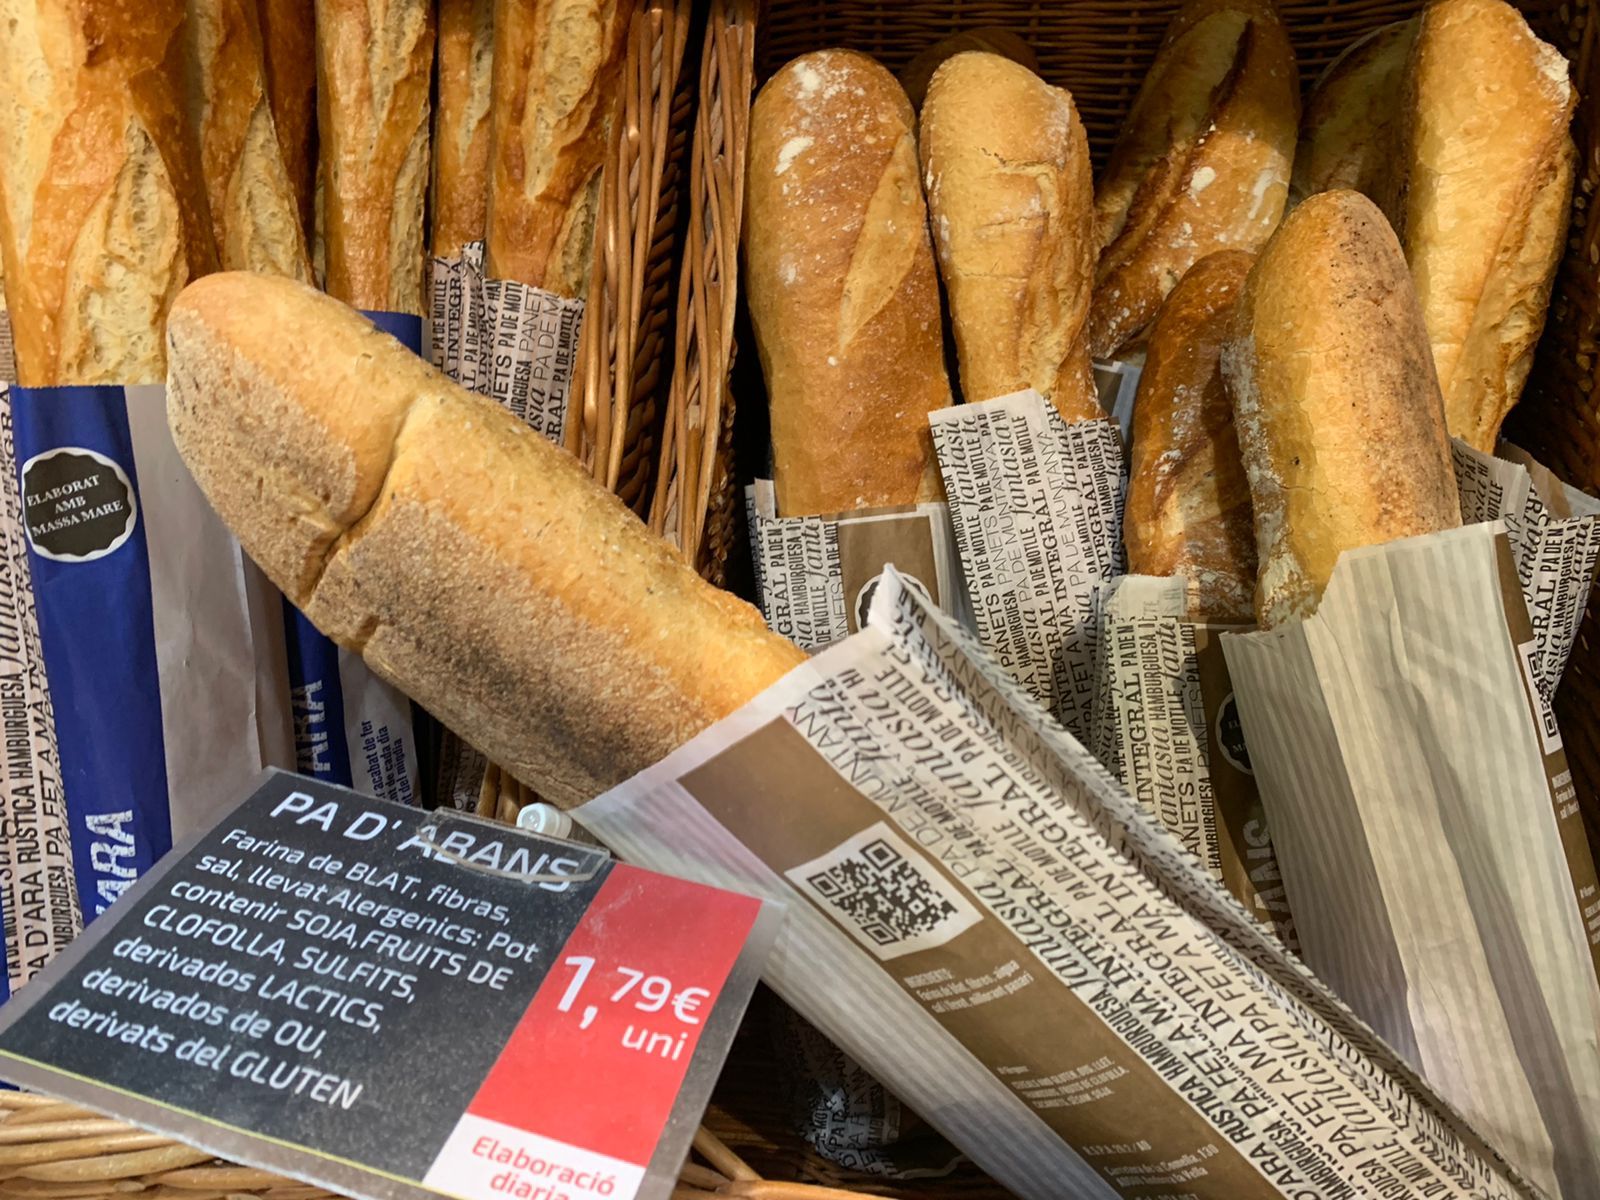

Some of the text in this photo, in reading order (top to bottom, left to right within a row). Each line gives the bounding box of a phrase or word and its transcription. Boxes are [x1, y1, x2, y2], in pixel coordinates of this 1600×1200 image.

[433, 279, 447, 350] PA DE MOTLLE
[498, 314, 518, 348] PA DE
[552, 306, 575, 382] PA DE MOTLLE
[464, 346, 477, 363] PA
[534, 323, 556, 381] PA DE
[1012, 415, 1035, 457] MOTLLE
[1023, 457, 1038, 471] DE
[1077, 456, 1088, 470] PA
[26, 474, 100, 507] ELABORAT
[54, 495, 87, 514] AMB
[1027, 470, 1040, 486] PA
[1087, 438, 1114, 514] HAMBURGUESA
[31, 499, 124, 538] MASSA MARE
[1032, 488, 1067, 602] INTEGRAL
[1072, 504, 1090, 544] MOTLLE
[769, 552, 785, 568] PA
[786, 535, 809, 616] HAMBURGUESA
[967, 438, 1032, 668] HAMBURGUESA PANETS PA DE MOTLLE
[985, 442, 1053, 699] fantasia PA DE MUNTANYA
[995, 425, 1076, 713] INTEGRAL PA DE MOTLLE fantasia
[1069, 561, 1086, 586] PA
[1540, 539, 1562, 573] PA DE
[1552, 536, 1575, 629] HAMBURGUESA
[810, 586, 832, 643] DE MOTLLE
[967, 514, 1015, 668] PANETS PA DE MOTLLE
[1067, 640, 1082, 653] A
[1560, 592, 1577, 658] DE MOTLLE
[1070, 659, 1090, 694] FET
[1139, 633, 1166, 721] HAMBURGUESA
[1, 673, 33, 779] HAMBURGUESA
[1118, 635, 1155, 804] INTEGRAL PA DE
[1167, 690, 1193, 774] PA DE MOTLLE
[37, 749, 53, 767] A
[11, 783, 41, 864] RUSTICA
[39, 769, 60, 818] FET
[891, 772, 953, 825] MOTLLE
[46, 826, 65, 857] PA
[270, 791, 580, 893] PA D' ABANS
[900, 809, 944, 847] DE
[947, 821, 974, 843] DE
[965, 835, 991, 856] PA
[222, 829, 513, 926] Farina de BLAT, fibras,
[939, 843, 978, 879] PA
[20, 869, 48, 948] D'ARA
[170, 879, 287, 925] contenir
[467, 961, 513, 990] DE
[196, 852, 541, 964] sal, llevat Alergenics: Pot
[856, 687, 1366, 1160] PA FET A MÀ INTEGRAL PA DE MOTLLE fantasia
[874, 663, 1448, 1197] DE MOTLLE fantasia PA FET A MÀ INTEGRAL PA DE MOTLLE
[973, 877, 1105, 995] fantasia
[989, 856, 1135, 990] INTEGRAL
[143, 905, 418, 1004] CLOFOLLA, SULFITS,
[81, 967, 327, 1059] derivados de OU,
[113, 937, 384, 1034] derivados LACTICS,
[1127, 986, 1172, 1025] MÀ
[48, 999, 363, 1110] derivats del GLUTEN
[621, 1024, 688, 1061] uni
[1087, 986, 1188, 1080] HAMBURGUESA
[1166, 1023, 1194, 1040] A
[1183, 1046, 1237, 1089] FET
[1176, 1074, 1256, 1144] RUSTICA
[1230, 1085, 1268, 1119] PA
[472, 1135, 616, 1196] Elaboració
[1197, 1143, 1220, 1159] 130
